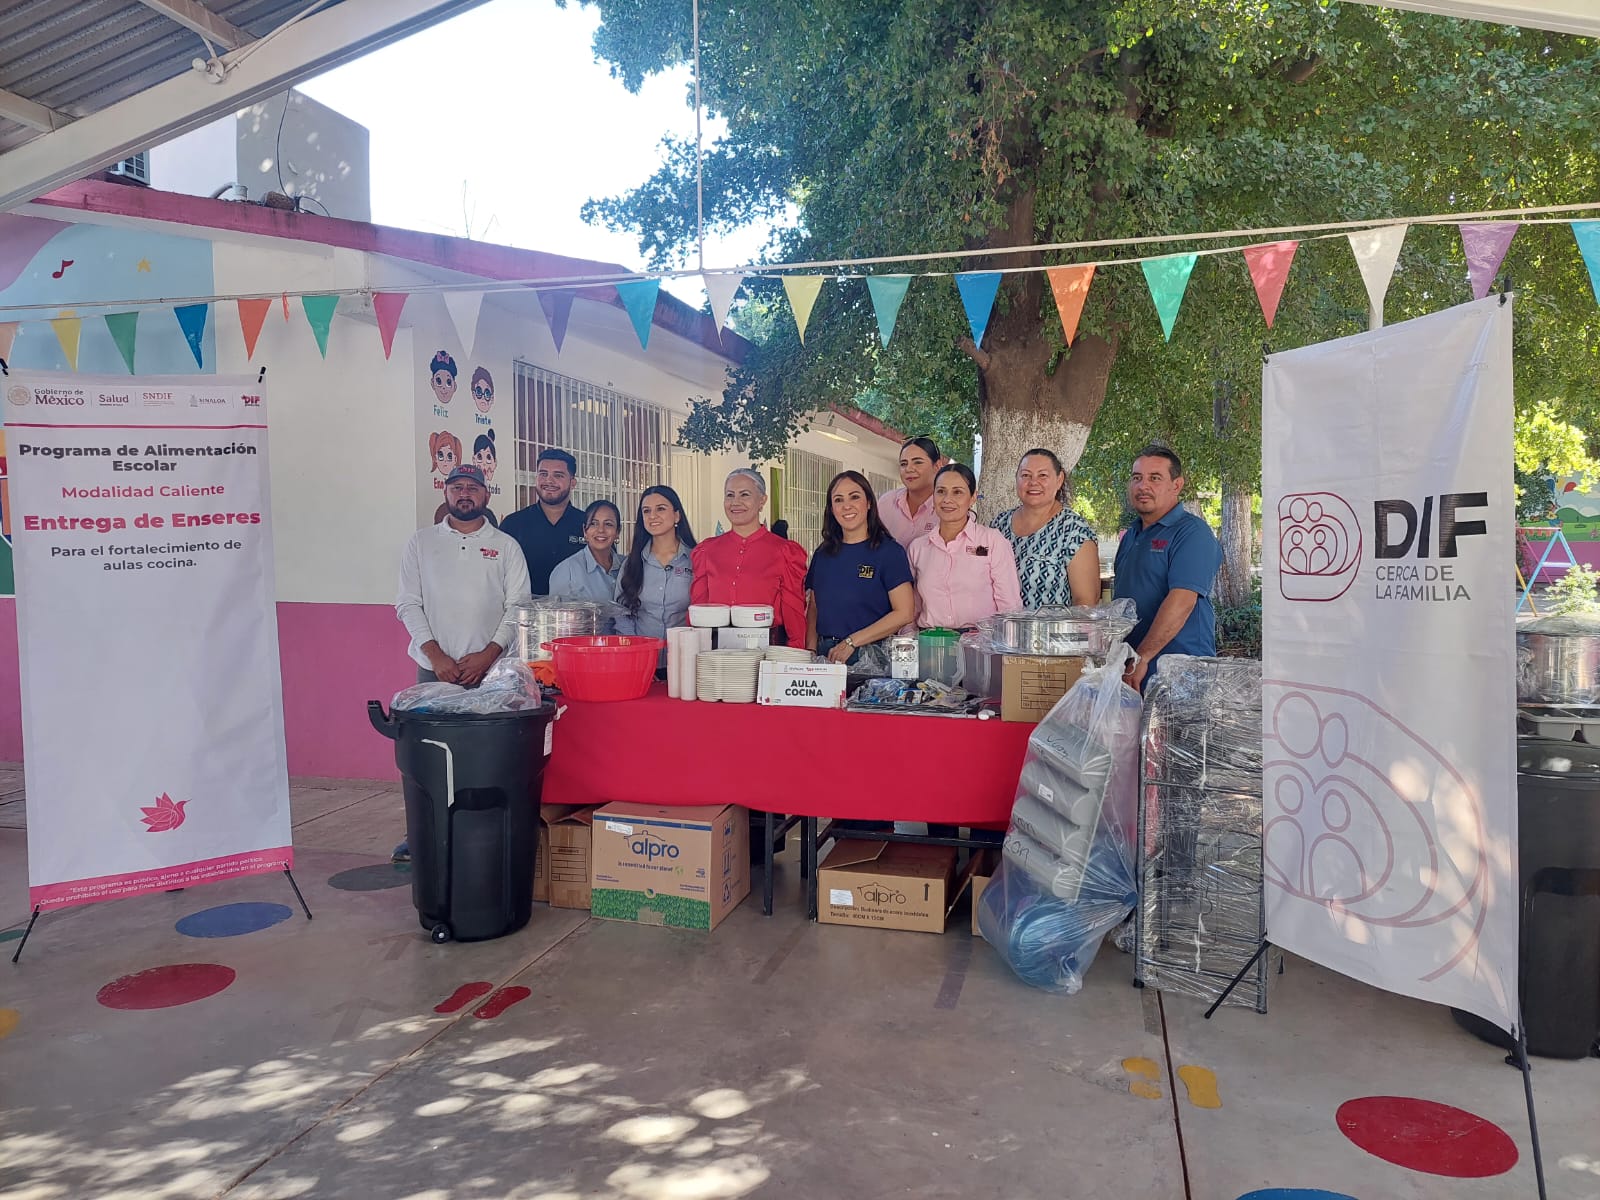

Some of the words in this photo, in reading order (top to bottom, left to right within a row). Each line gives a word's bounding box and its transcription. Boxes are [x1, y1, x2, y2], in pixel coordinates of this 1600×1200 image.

[35, 394, 85, 406] México
[98, 394, 129, 403] Salud
[142, 392, 173, 400] SNDIF
[433, 404, 449, 418] Feliz
[475, 412, 492, 425] Triste
[19, 444, 112, 459] Programa
[116, 445, 139, 456] de
[144, 442, 257, 456] Alimentación
[112, 460, 177, 472] Escolar
[61, 485, 154, 499] Modalidad
[159, 484, 225, 497] Caliente
[24, 515, 127, 533] Entrega
[134, 513, 166, 529] de
[172, 511, 262, 529] Enseres
[1374, 492, 1489, 560] DIF
[51, 546, 86, 558] Para
[90, 544, 104, 556] el
[108, 541, 220, 556] fortalecimiento
[223, 539, 242, 550] de
[103, 560, 143, 571] aulas
[147, 557, 197, 570] cocina.
[1375, 565, 1420, 582] CERCA
[1424, 565, 1455, 582] DE
[790, 680, 818, 688] AULA
[784, 688, 823, 697] COCINA
[631, 838, 680, 862] alpro
[65, 890, 101, 902] prohibido
[864, 888, 907, 906] alpro
